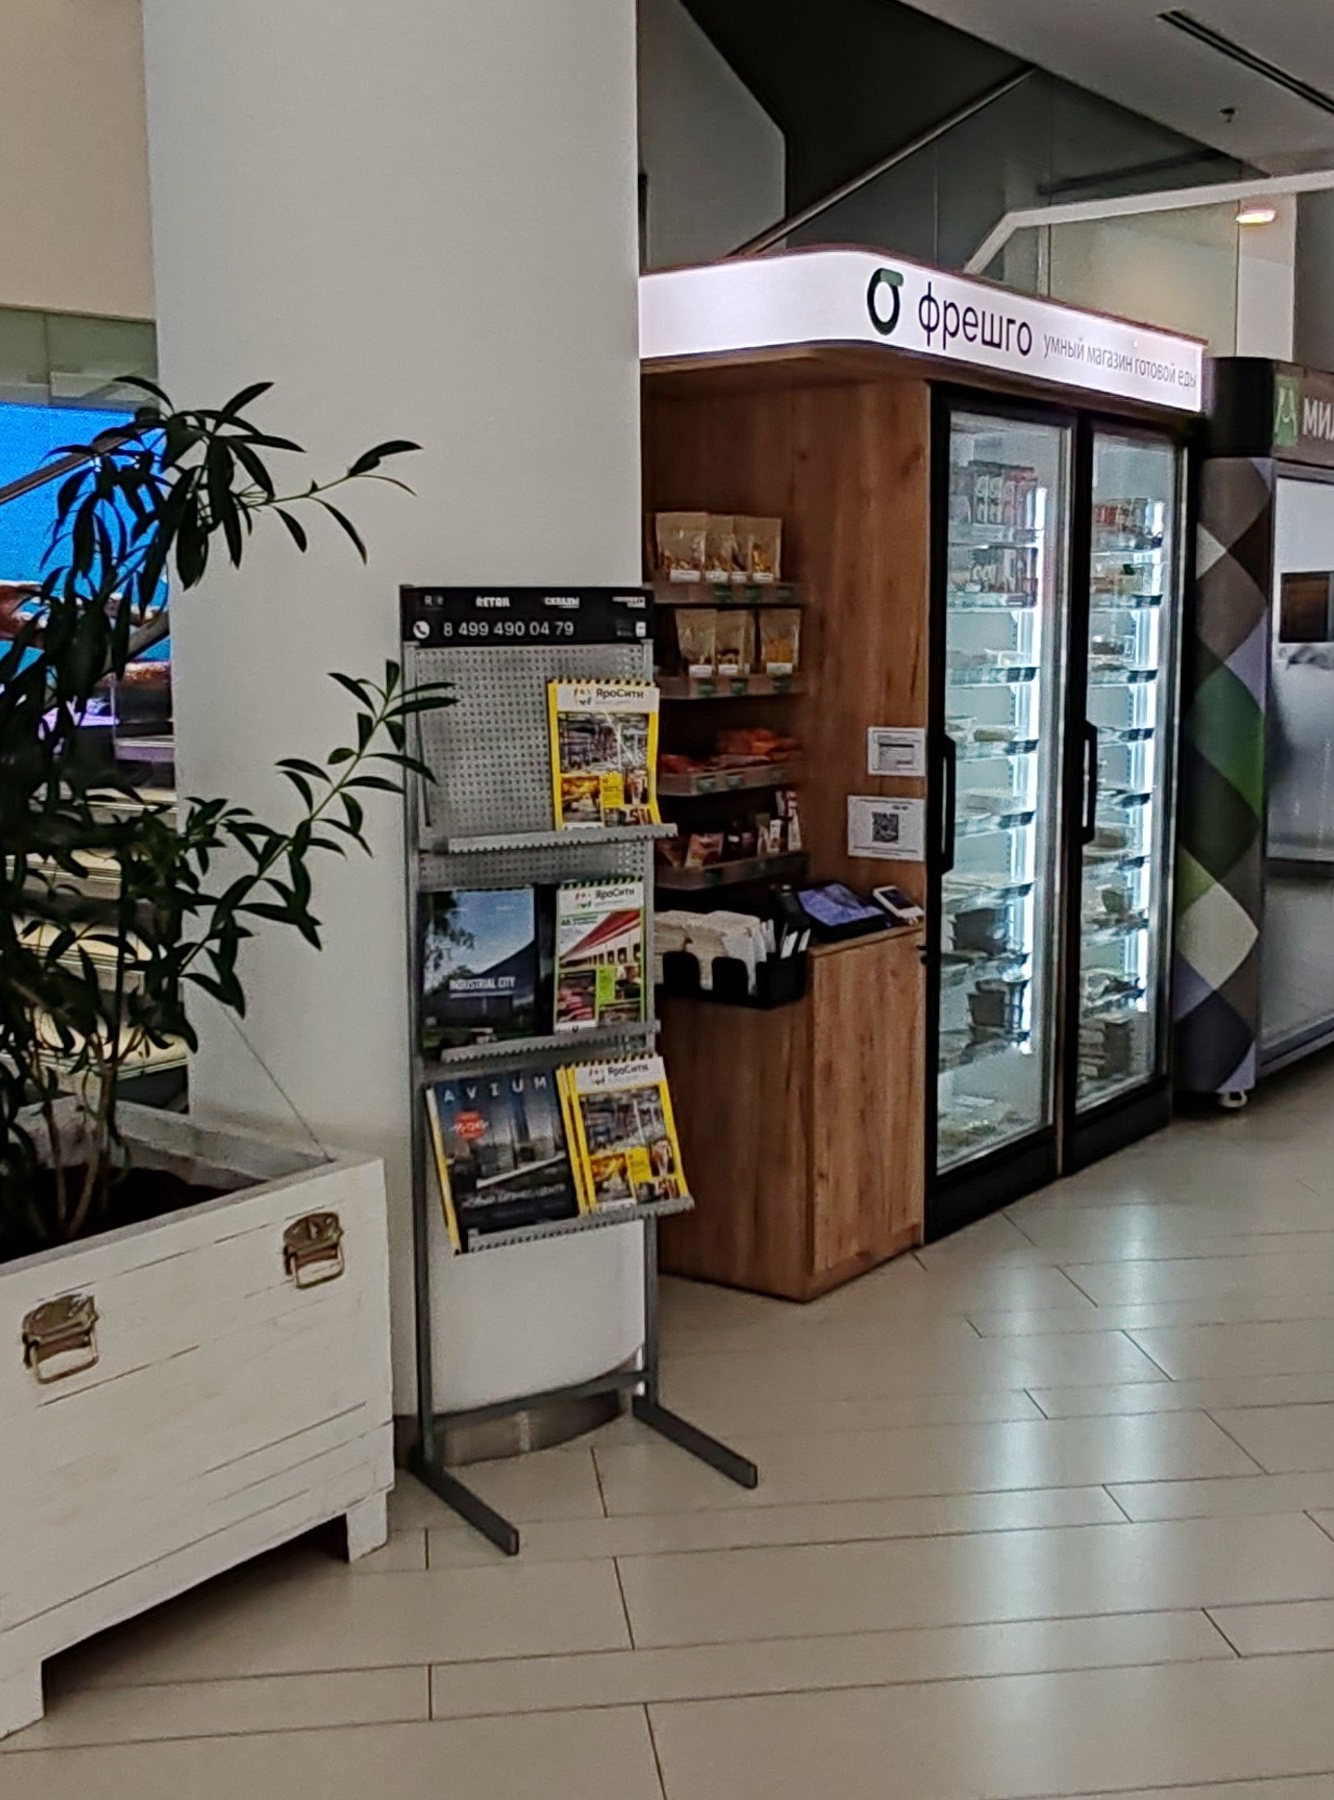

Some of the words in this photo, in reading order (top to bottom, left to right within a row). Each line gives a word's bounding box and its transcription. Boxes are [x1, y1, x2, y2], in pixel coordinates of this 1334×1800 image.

[919, 281, 1032, 356] фрешго
[1043, 333, 1085, 359] умный
[1087, 345, 1133, 373] магазин
[1134, 357, 1176, 383] готовой
[1177, 370, 1197, 391] еды
[443, 622, 453, 637] 8
[458, 621, 489, 636] 499
[493, 621, 525, 636] 490
[529, 621, 549, 636] 04
[554, 621, 574, 636] 79
[596, 688, 644, 699] ЯроСити
[595, 888, 635, 899] ЯроСити
[498, 976, 516, 988] CITY
[444, 1076, 547, 1102] AVIUM
